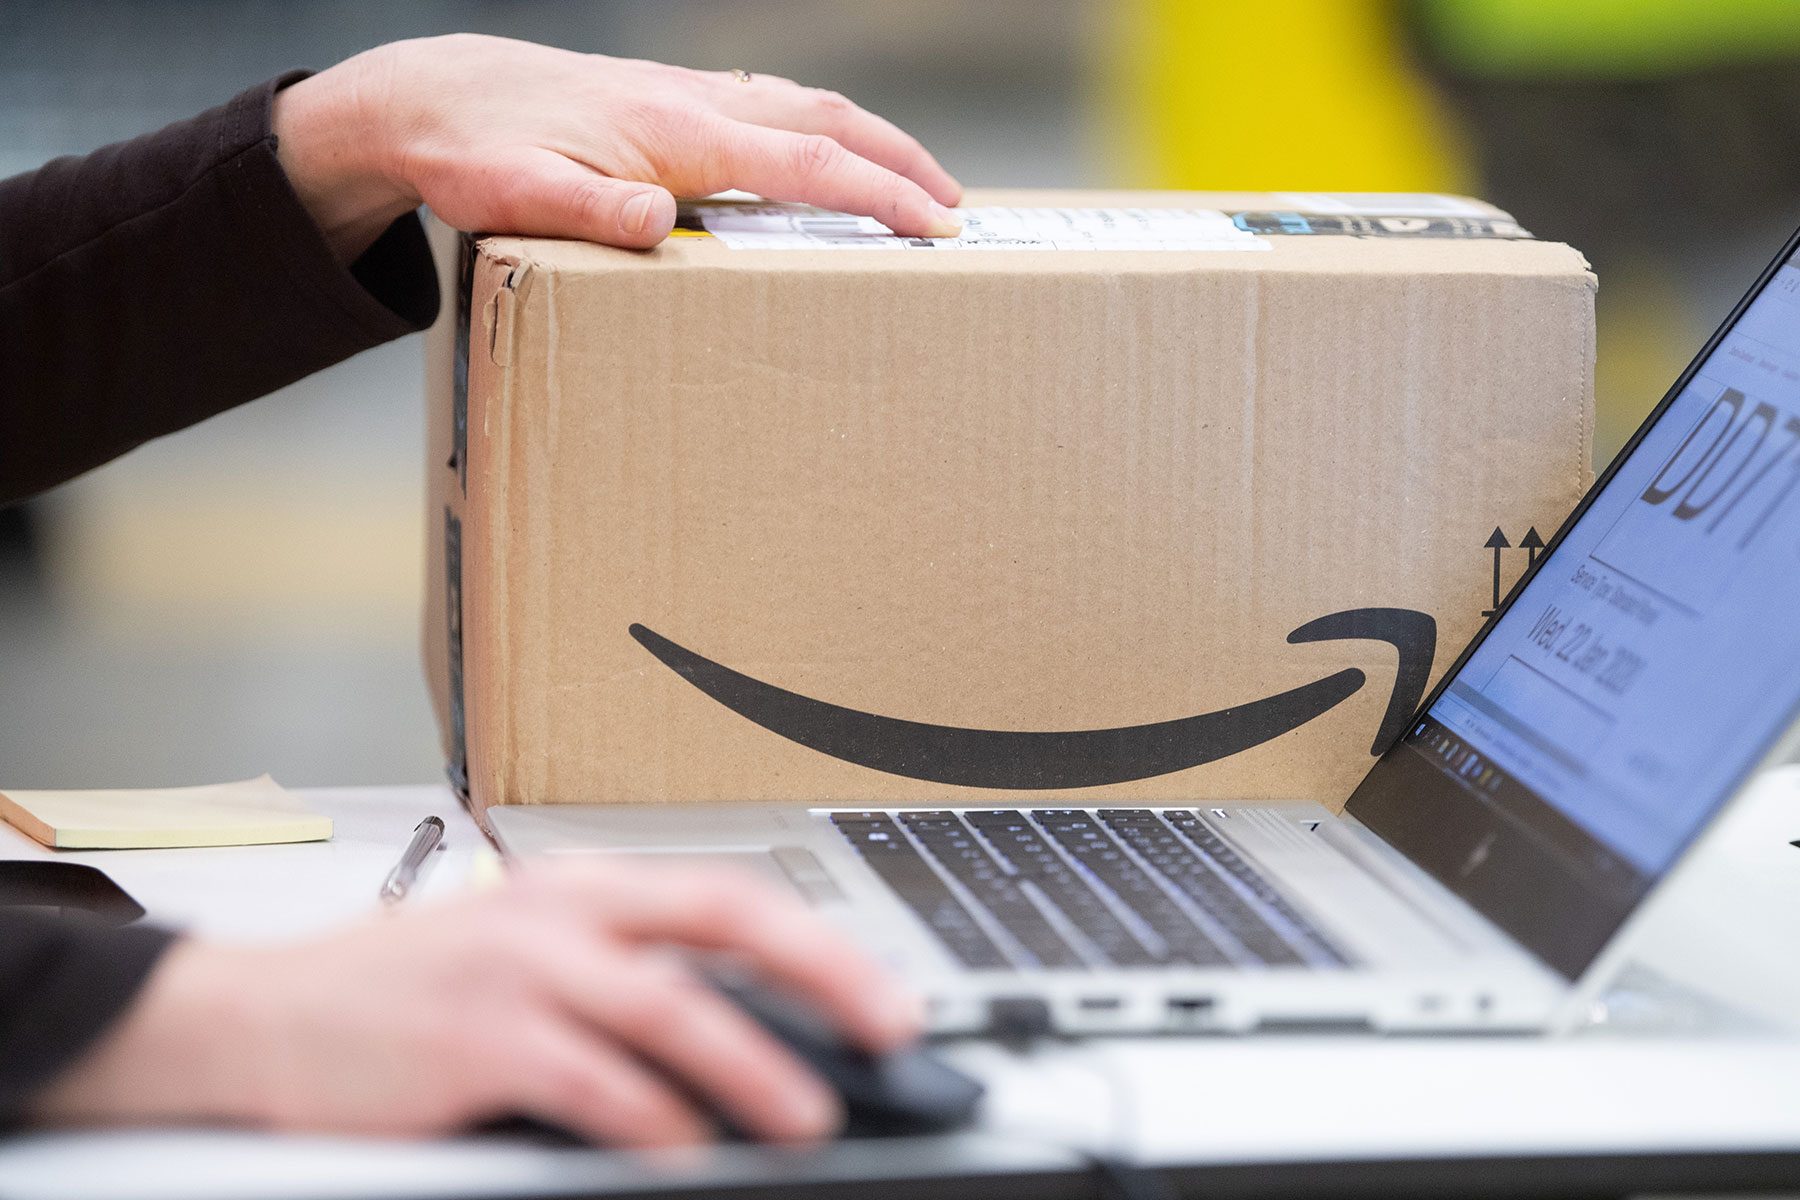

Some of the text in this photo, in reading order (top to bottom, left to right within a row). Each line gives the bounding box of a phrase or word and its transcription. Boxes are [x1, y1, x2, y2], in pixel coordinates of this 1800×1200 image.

[1570, 564, 1600, 591] Service
[1526, 604, 1575, 657] Wed,
[1556, 624, 1594, 662] 22
